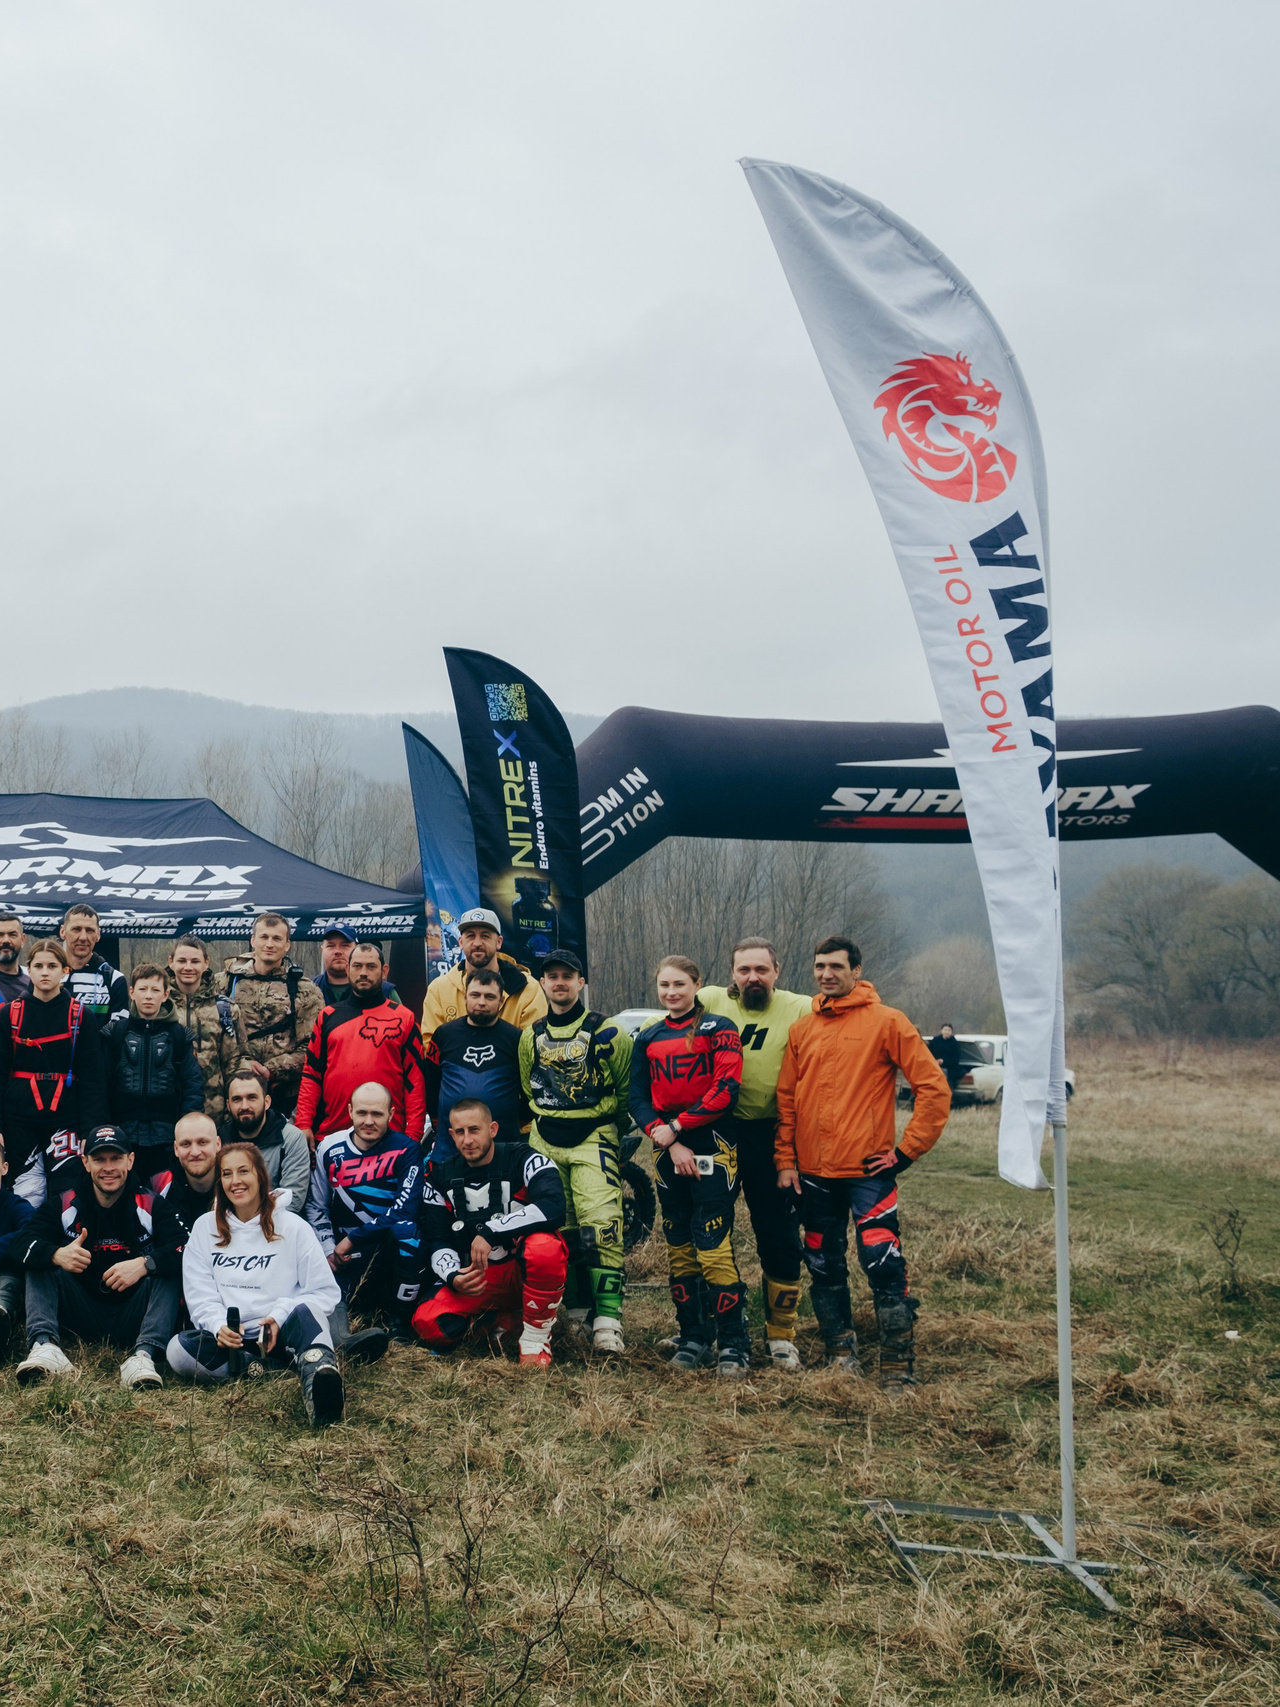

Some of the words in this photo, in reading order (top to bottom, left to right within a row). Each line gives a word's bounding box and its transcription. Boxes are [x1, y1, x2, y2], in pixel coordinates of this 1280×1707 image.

[934, 544, 974, 606] OIL
[957, 614, 1017, 753] MOTOR
[493, 729, 535, 868] NITREX
[526, 760, 542, 818] vitamins
[619, 766, 650, 797] IN
[535, 819, 549, 870] Enduro
[94, 887, 248, 901] RACE
[311, 915, 418, 928] SHARMAX
[519, 918, 553, 928] NITREX
[243, 1253, 278, 1271] CAT
